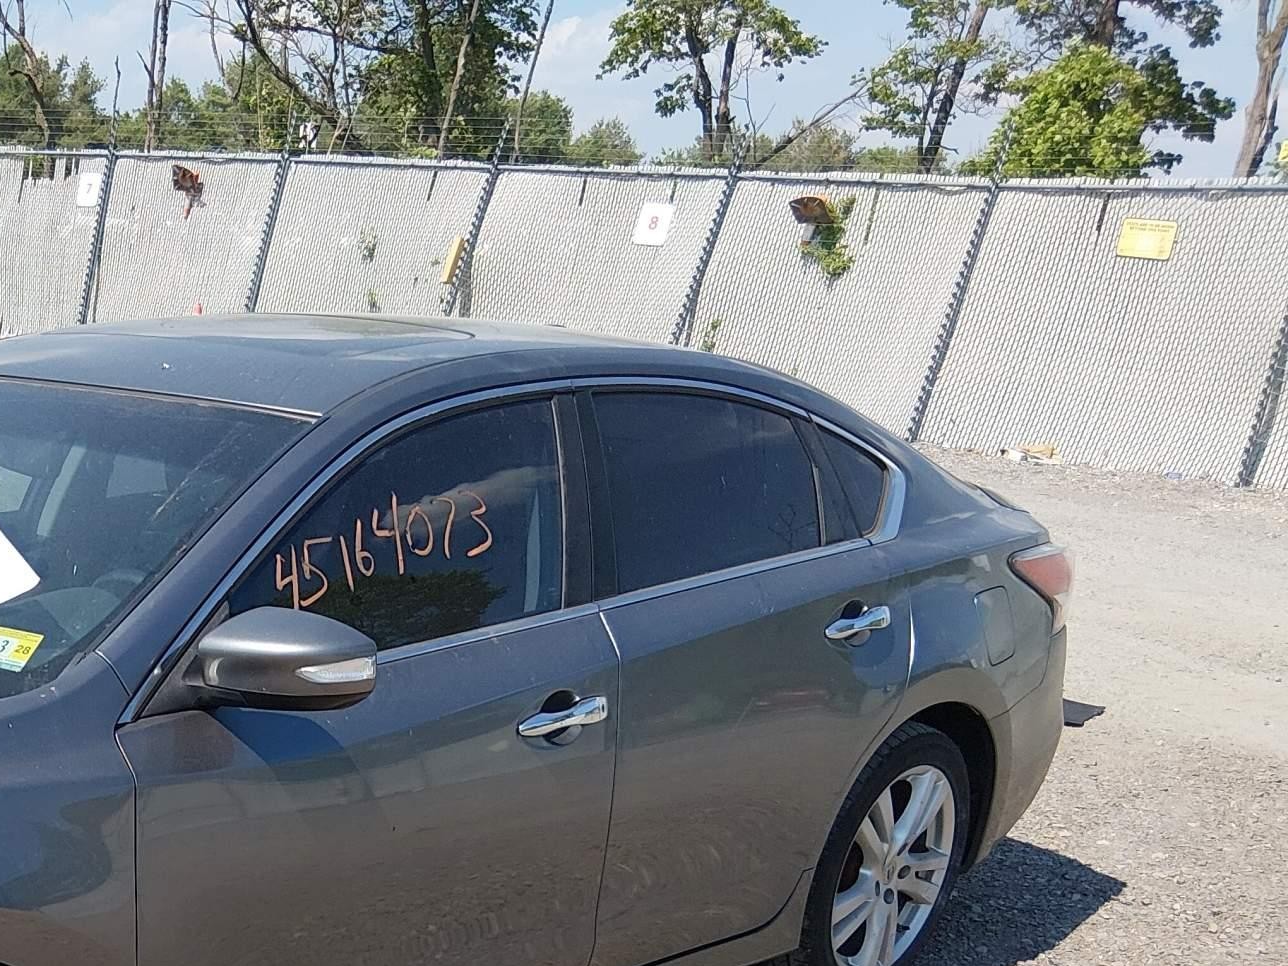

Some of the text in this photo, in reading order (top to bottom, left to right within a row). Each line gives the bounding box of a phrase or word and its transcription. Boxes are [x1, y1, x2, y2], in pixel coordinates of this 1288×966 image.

[86, 183, 93, 194] 7
[648, 216, 659, 230] 8
[275, 489, 493, 611] 45164073
[14, 645, 32, 655] 28
